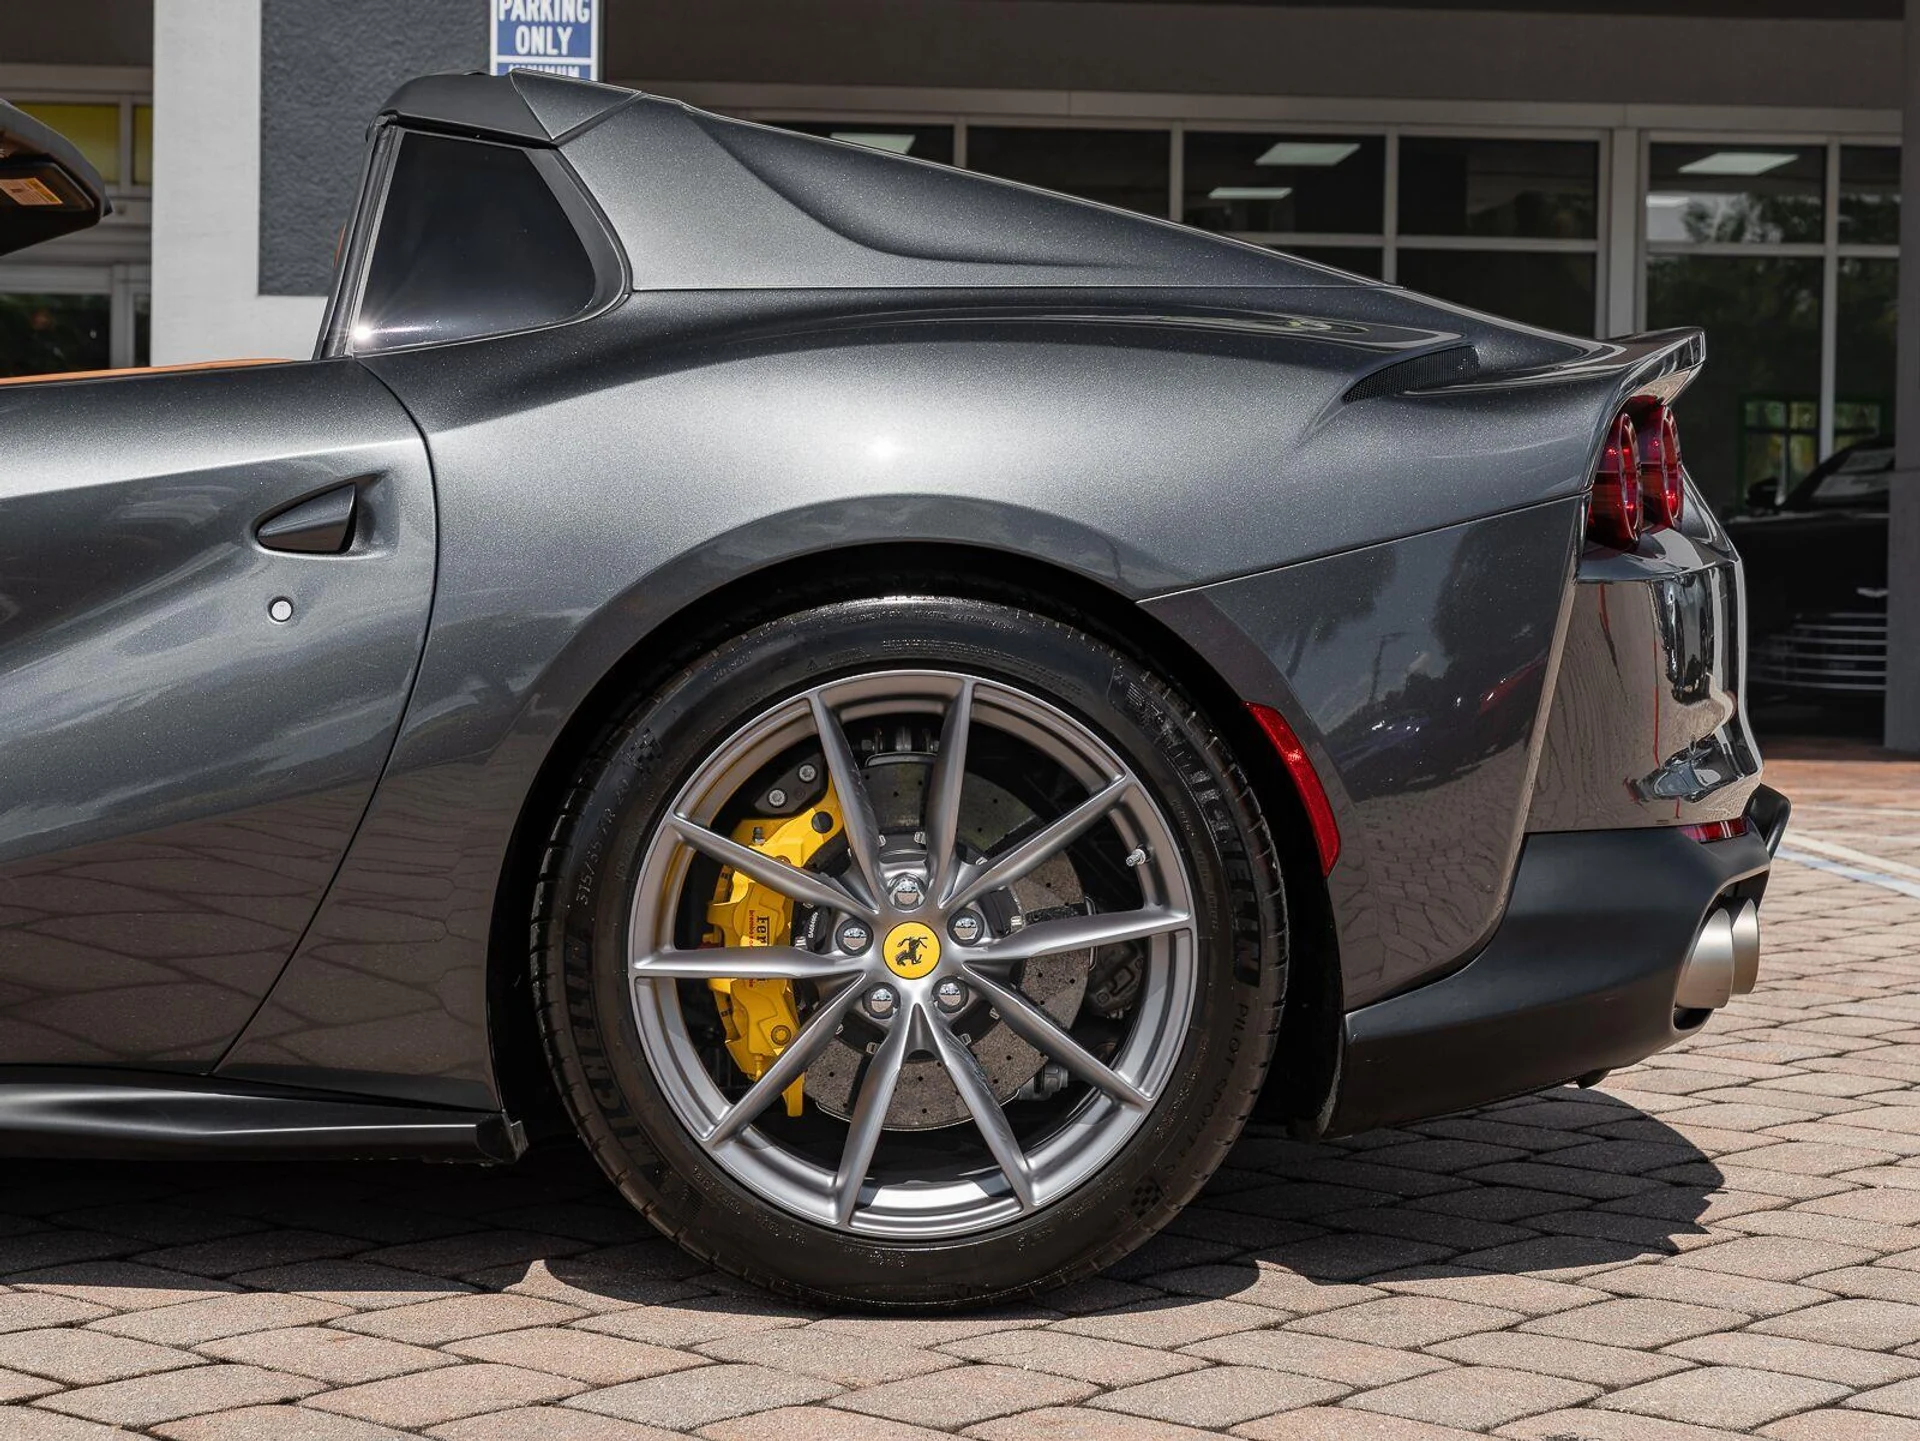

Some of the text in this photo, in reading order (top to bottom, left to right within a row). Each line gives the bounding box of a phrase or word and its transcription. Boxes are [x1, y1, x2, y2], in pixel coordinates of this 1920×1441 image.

[499, 0, 590, 23] PARKING
[515, 25, 572, 55] ONLY
[566, 937, 659, 1167] MICHELIN
[1223, 1003, 1249, 1065] PILOT
[1187, 1077, 1228, 1147] SPORT
